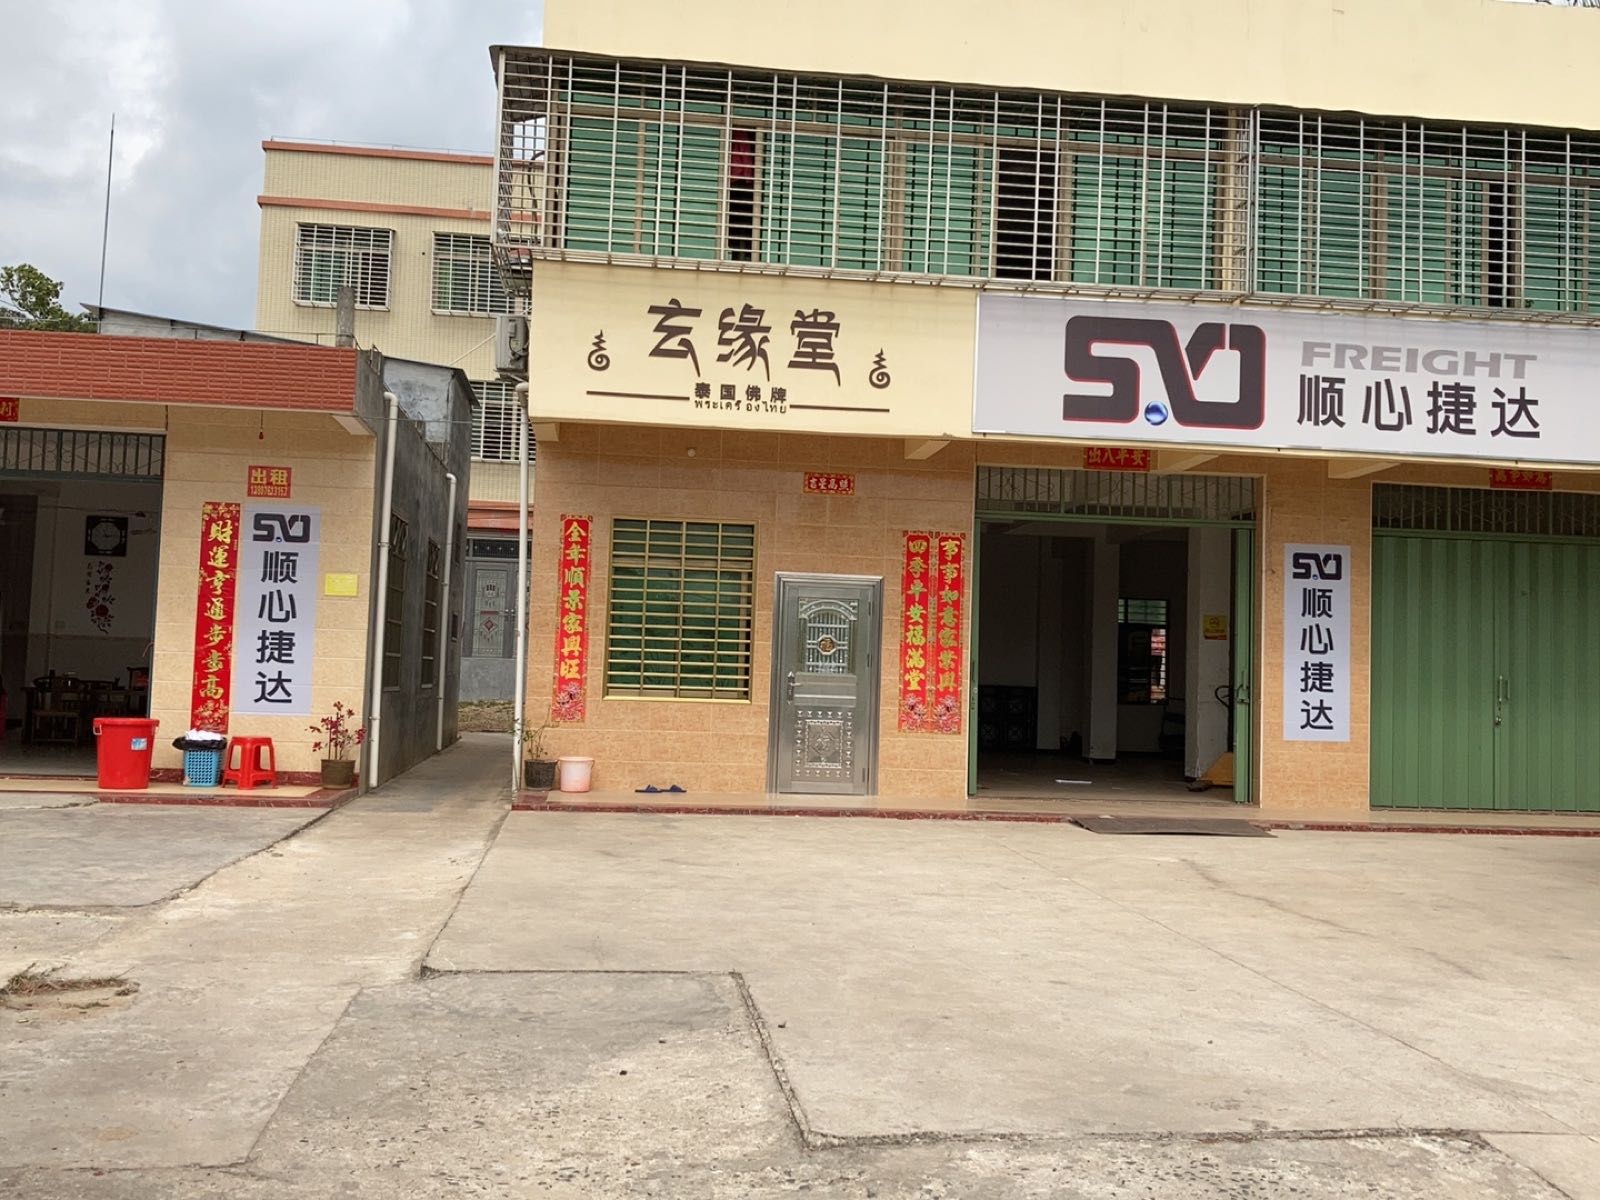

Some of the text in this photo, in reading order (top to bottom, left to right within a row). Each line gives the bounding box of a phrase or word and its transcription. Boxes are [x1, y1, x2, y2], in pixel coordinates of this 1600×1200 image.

[647, 298, 841, 387] 玄缘堂
[1301, 341, 1537, 379] FREIGHT
[695, 382, 787, 403] 泰国佛牌
[1297, 374, 1540, 438] 顺心捷达
[251, 468, 289, 485] 出租
[254, 551, 299, 703] 顺心捷达
[1300, 588, 1334, 730] 顺心捷达
